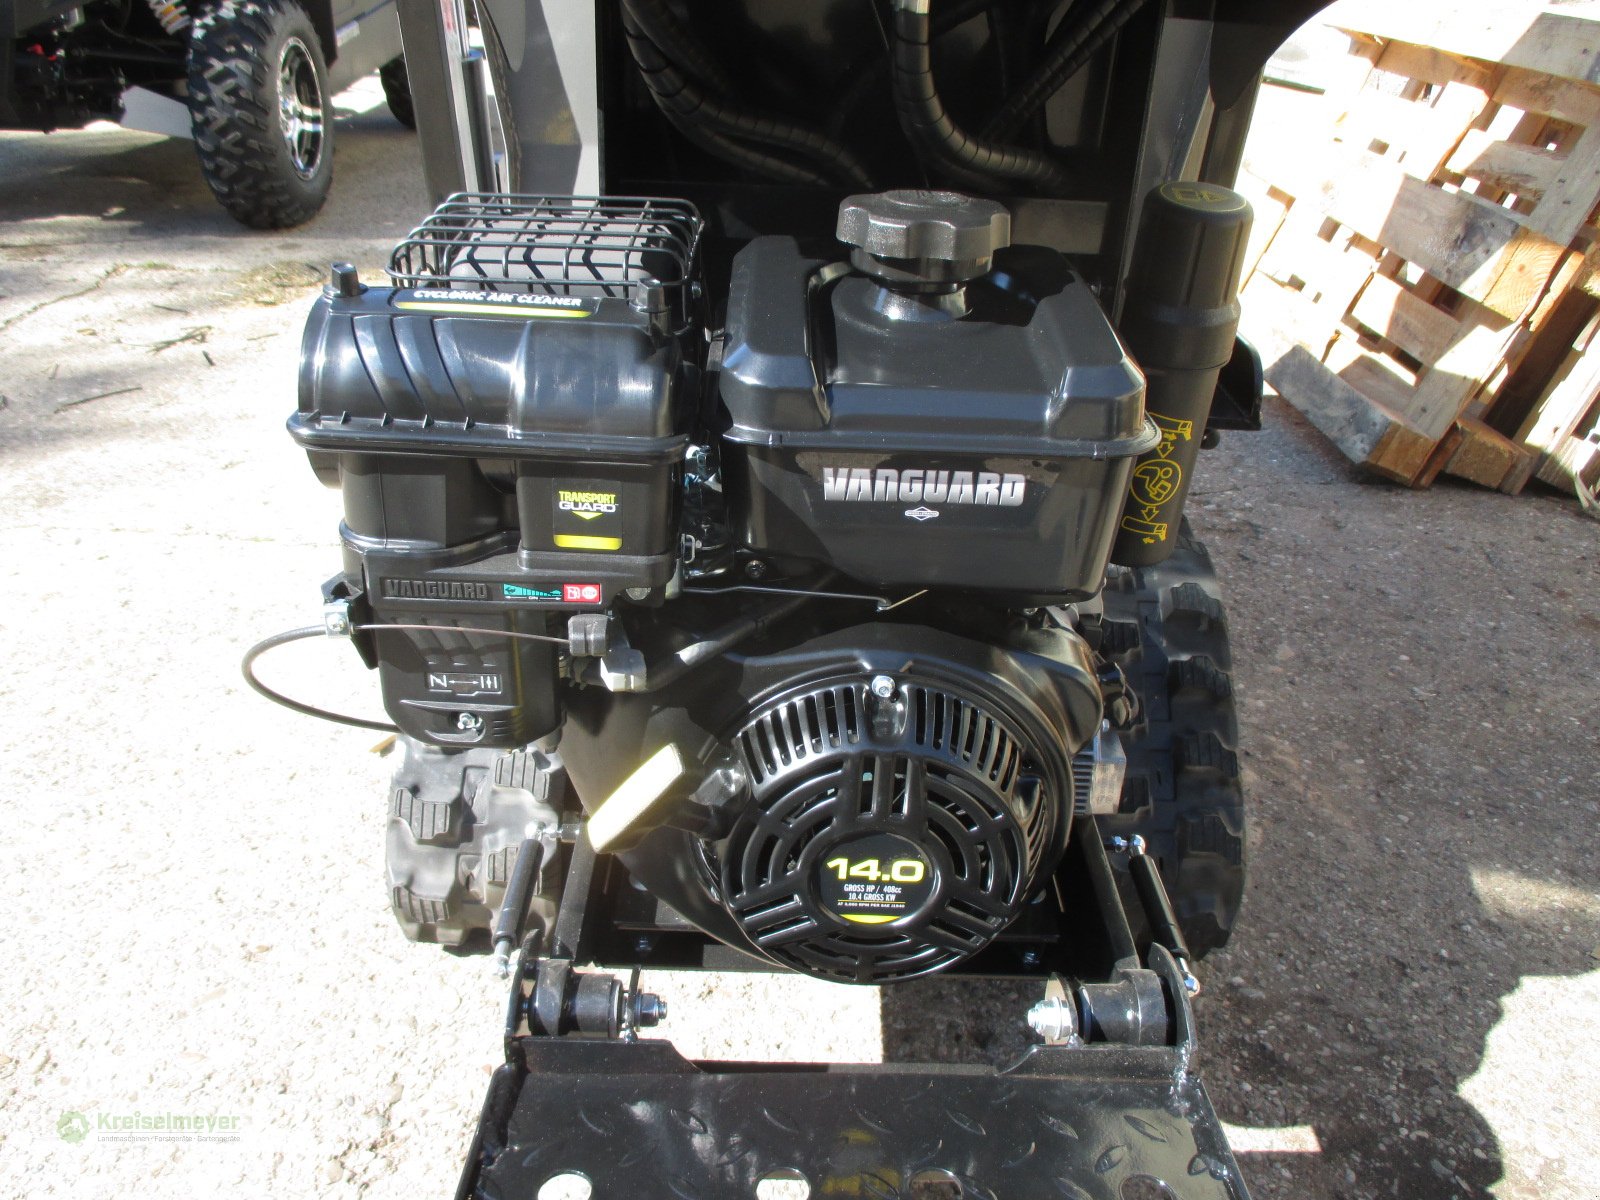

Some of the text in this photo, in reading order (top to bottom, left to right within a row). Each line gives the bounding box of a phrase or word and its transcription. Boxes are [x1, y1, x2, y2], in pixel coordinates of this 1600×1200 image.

[413, 290, 582, 306] CYCLONIC AIR CLEANER
[822, 467, 1026, 507] VANGUARD
[558, 490, 616, 504] TRANSPORT
[558, 500, 617, 513] GUARD
[385, 579, 489, 600] VANGUARD
[827, 858, 924, 882] 14.0
[844, 884, 865, 892] GROSS
[883, 885, 902, 894] 408cc
[848, 892, 862, 900] 10.4
[863, 893, 885, 901] GROSS
